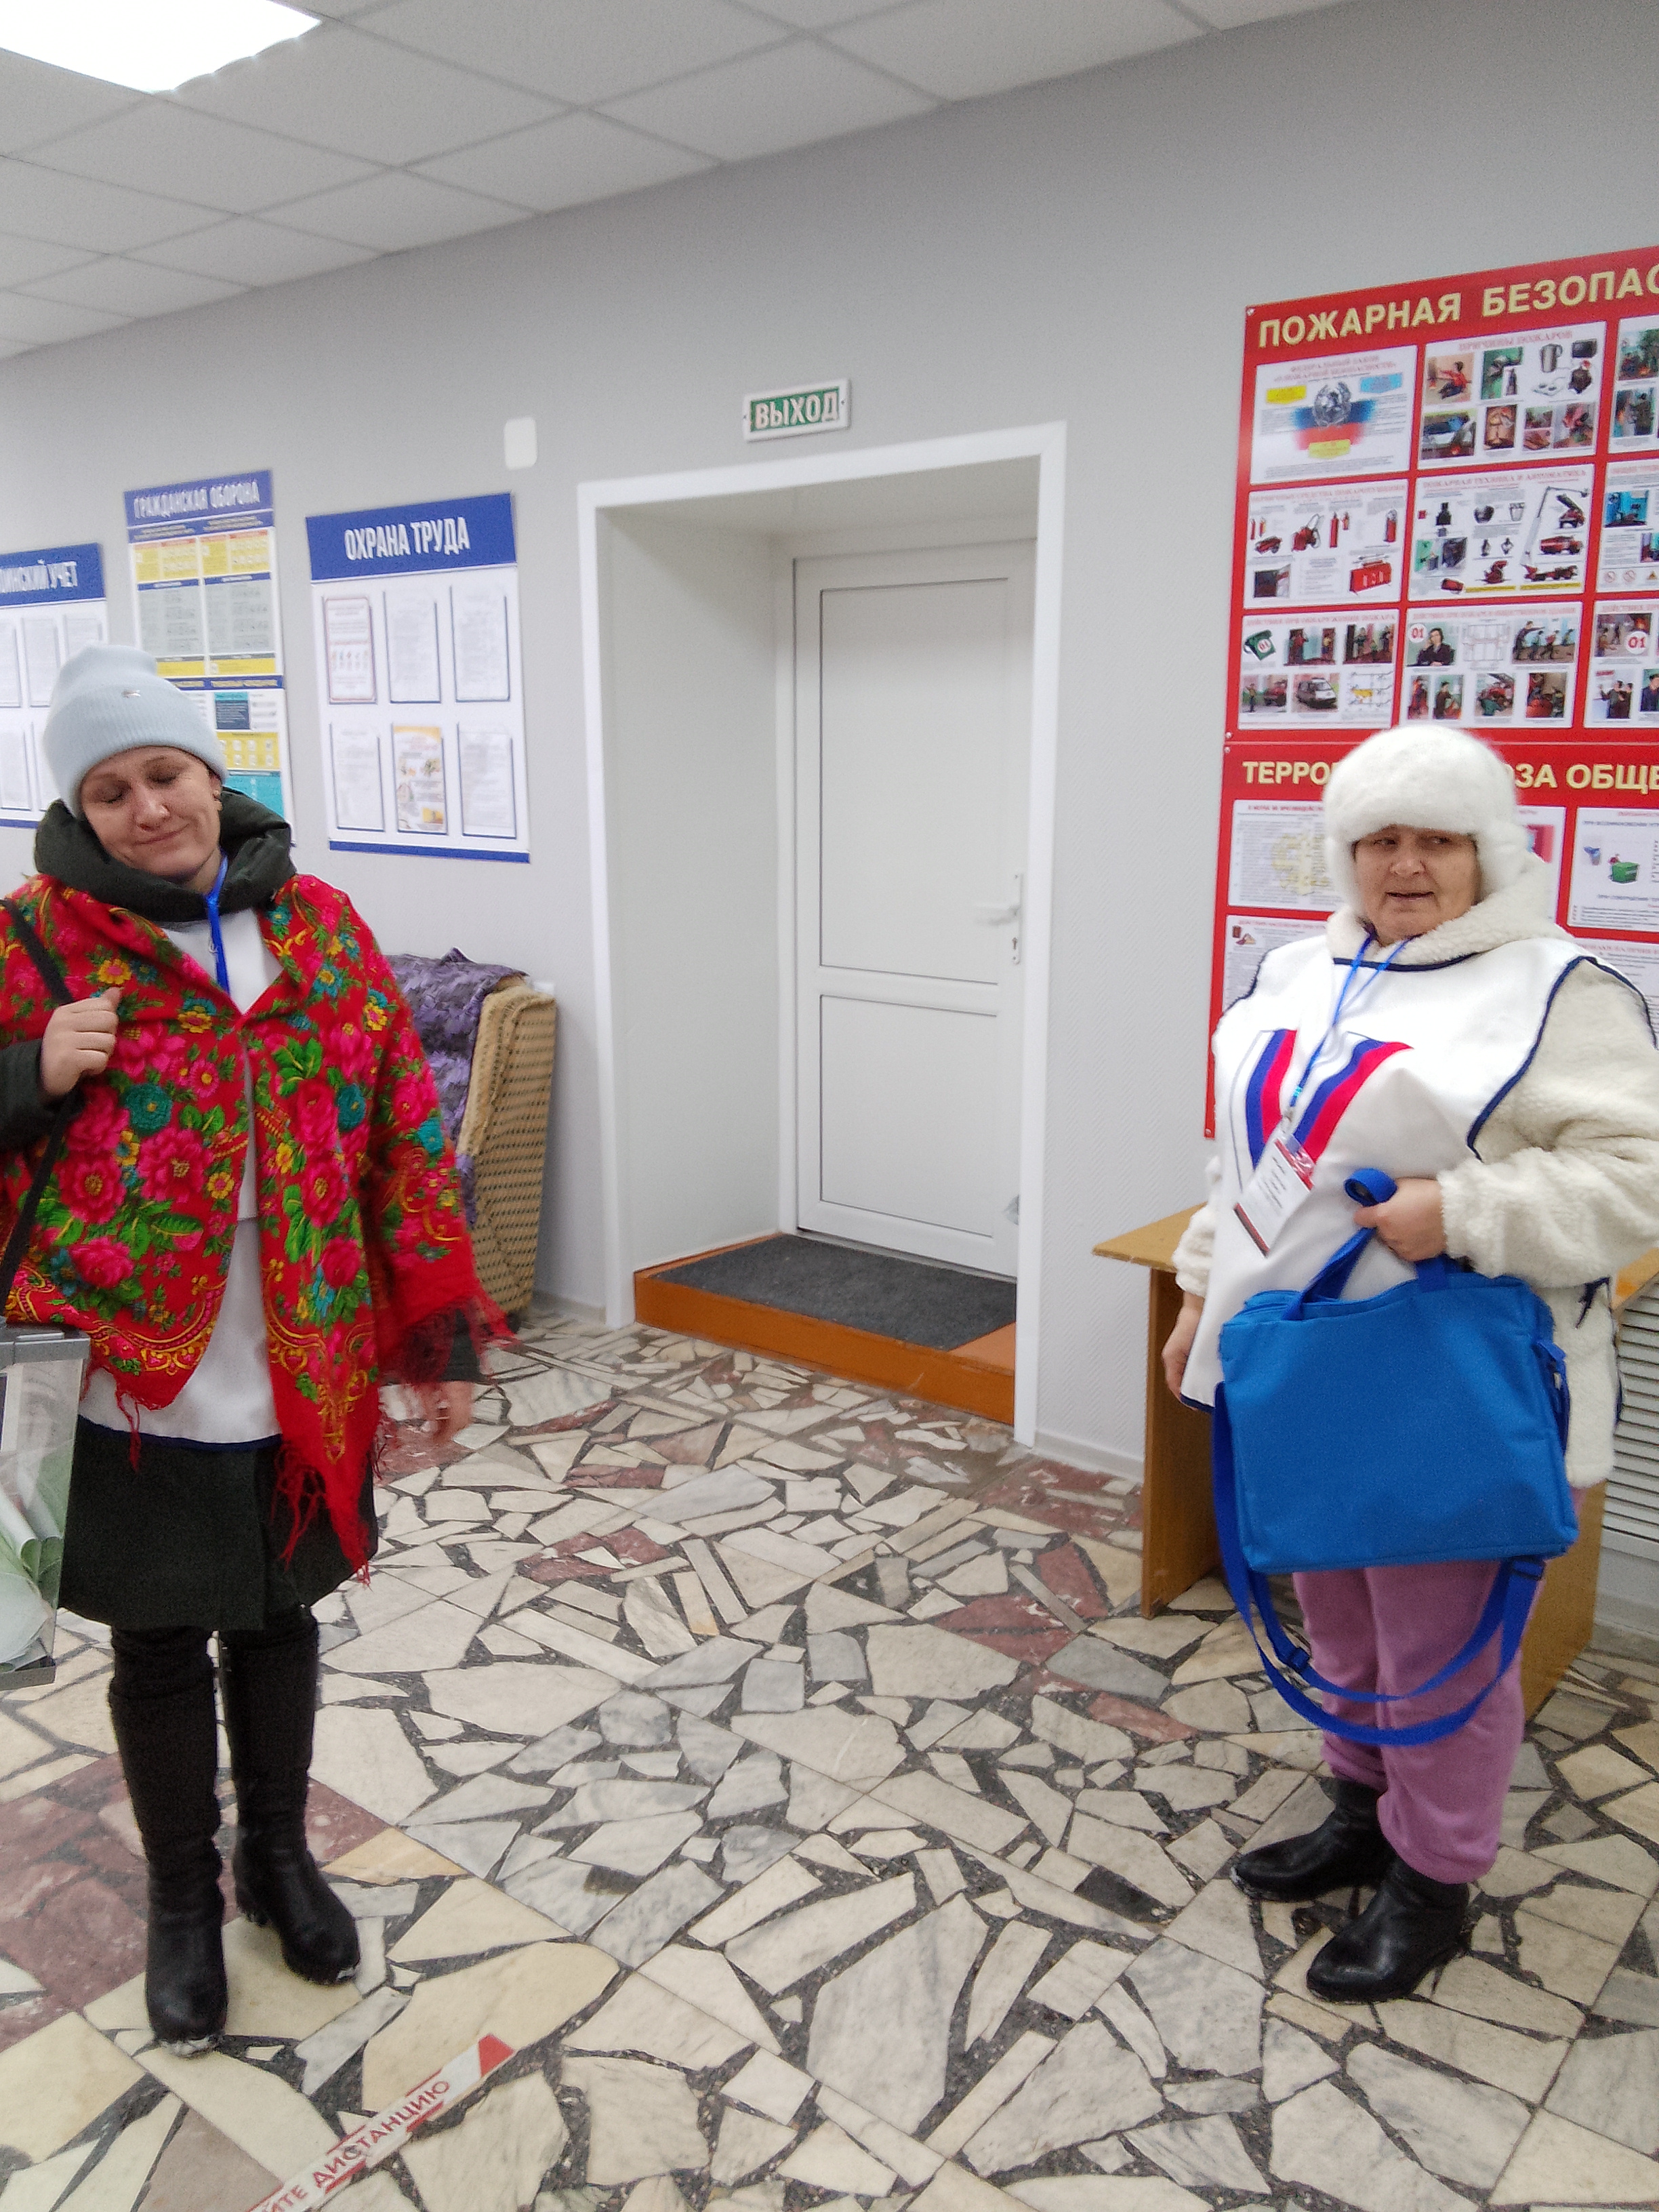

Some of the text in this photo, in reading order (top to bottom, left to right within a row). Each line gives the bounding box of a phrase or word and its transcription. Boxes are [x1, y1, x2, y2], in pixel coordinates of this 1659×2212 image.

[1258, 292, 1462, 348] ПОЖАРНАЯ
[755, 391, 839, 429] ВЫХОД
[209, 480, 260, 508] ОБОРОНА
[344, 516, 470, 561] ОХРАНА ТРУДА
[1628, 636, 1645, 649] 01
[1242, 761, 1339, 785] ТЕРРО
[313, 2081, 451, 2189] ДИСТАНЦИЮ
